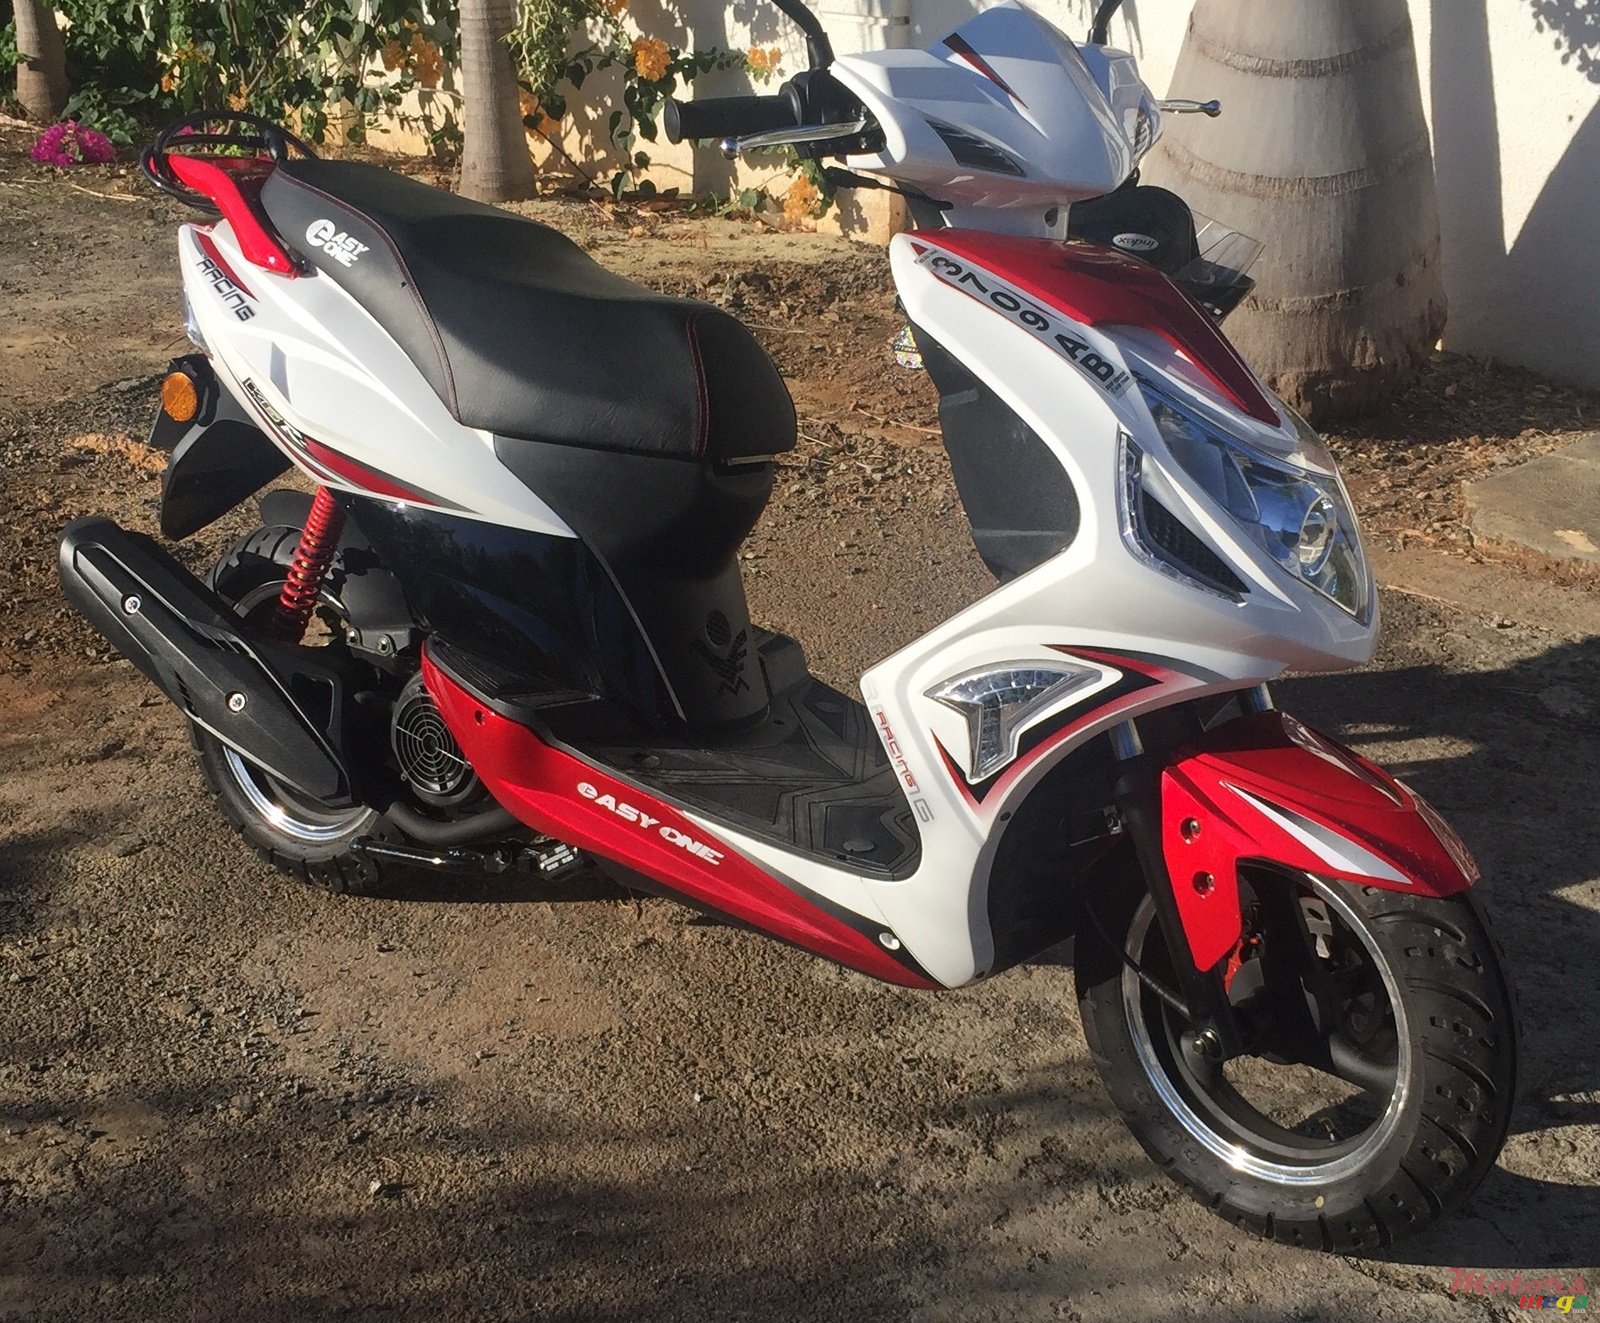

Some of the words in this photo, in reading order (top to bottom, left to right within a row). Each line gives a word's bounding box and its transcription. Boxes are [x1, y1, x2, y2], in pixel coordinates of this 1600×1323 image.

[323, 241, 358, 268] ONE
[196, 258, 255, 322] RACING
[930, 256, 1049, 332] 3709
[1054, 333, 1115, 382] AB
[659, 826, 725, 866] ONE
